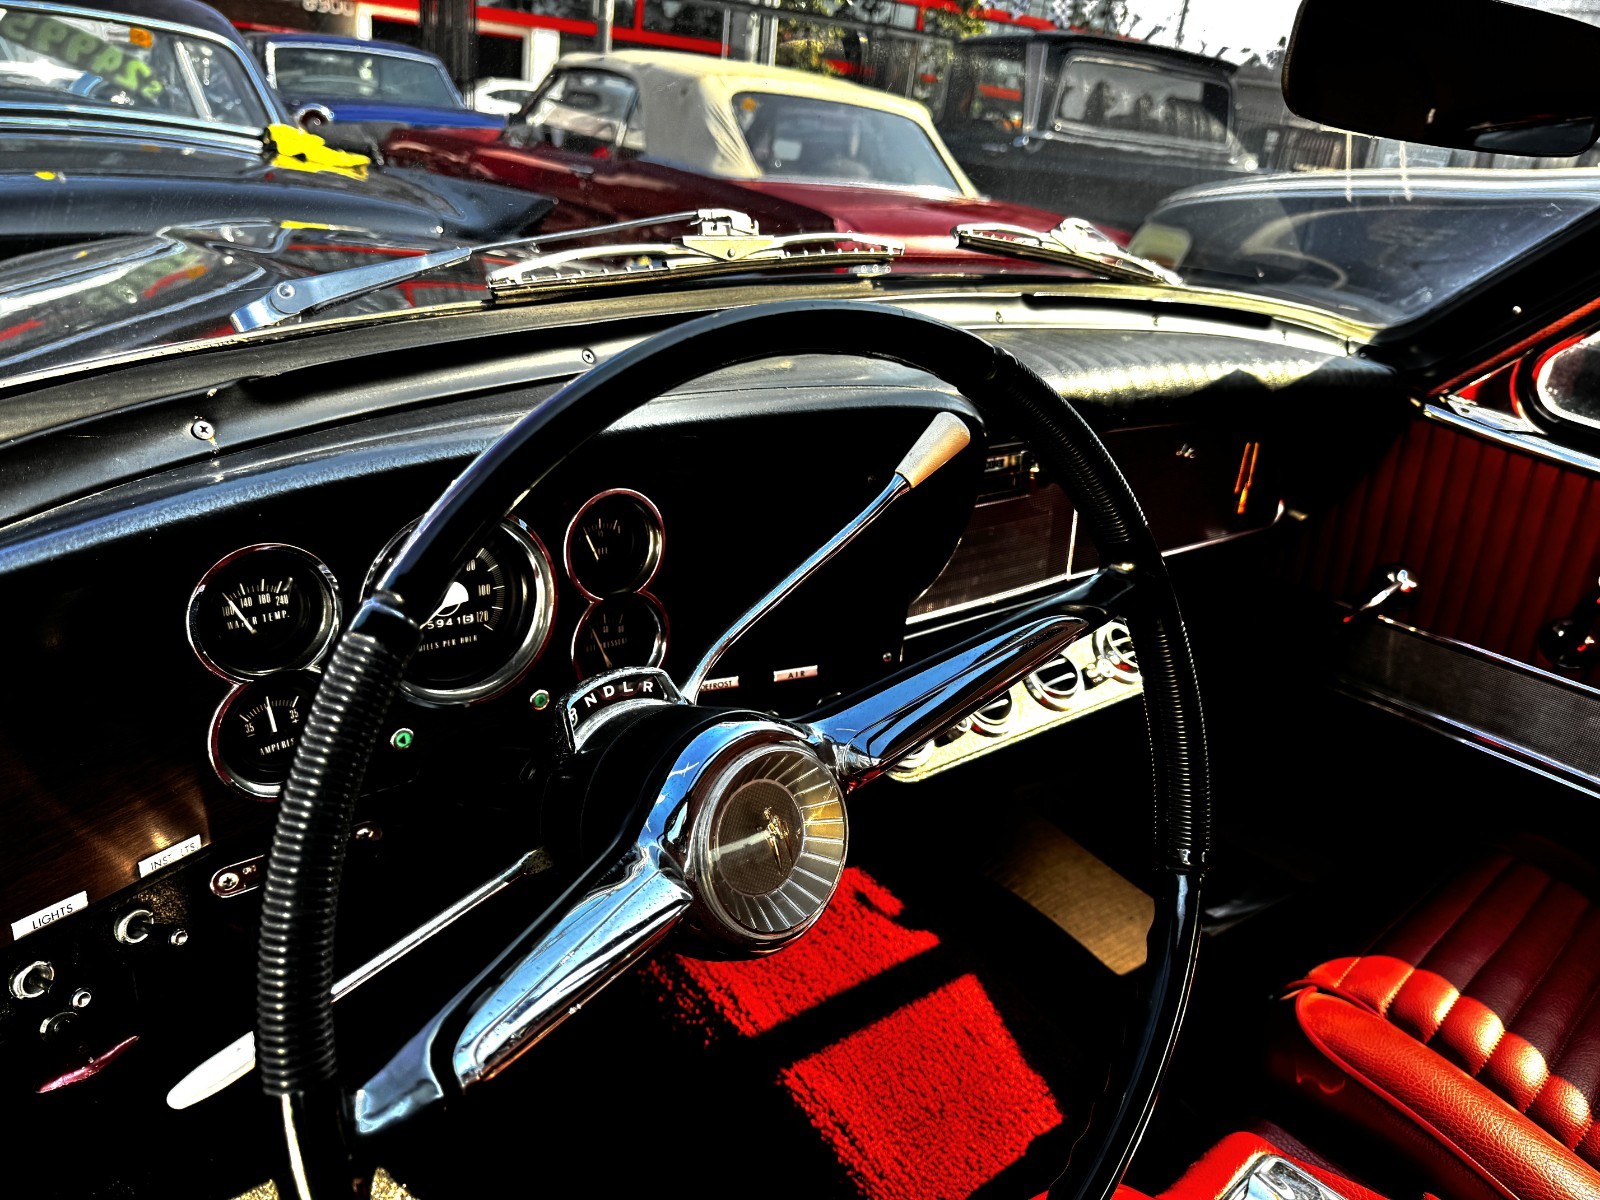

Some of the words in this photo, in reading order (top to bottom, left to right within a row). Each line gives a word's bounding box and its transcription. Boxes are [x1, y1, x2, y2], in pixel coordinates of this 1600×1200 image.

[478, 584, 491, 596] 100
[227, 616, 258, 630] WAR
[477, 610, 489, 623] 120
[787, 670, 806, 679] AIR
[32, 903, 73, 930] LIGHTS
